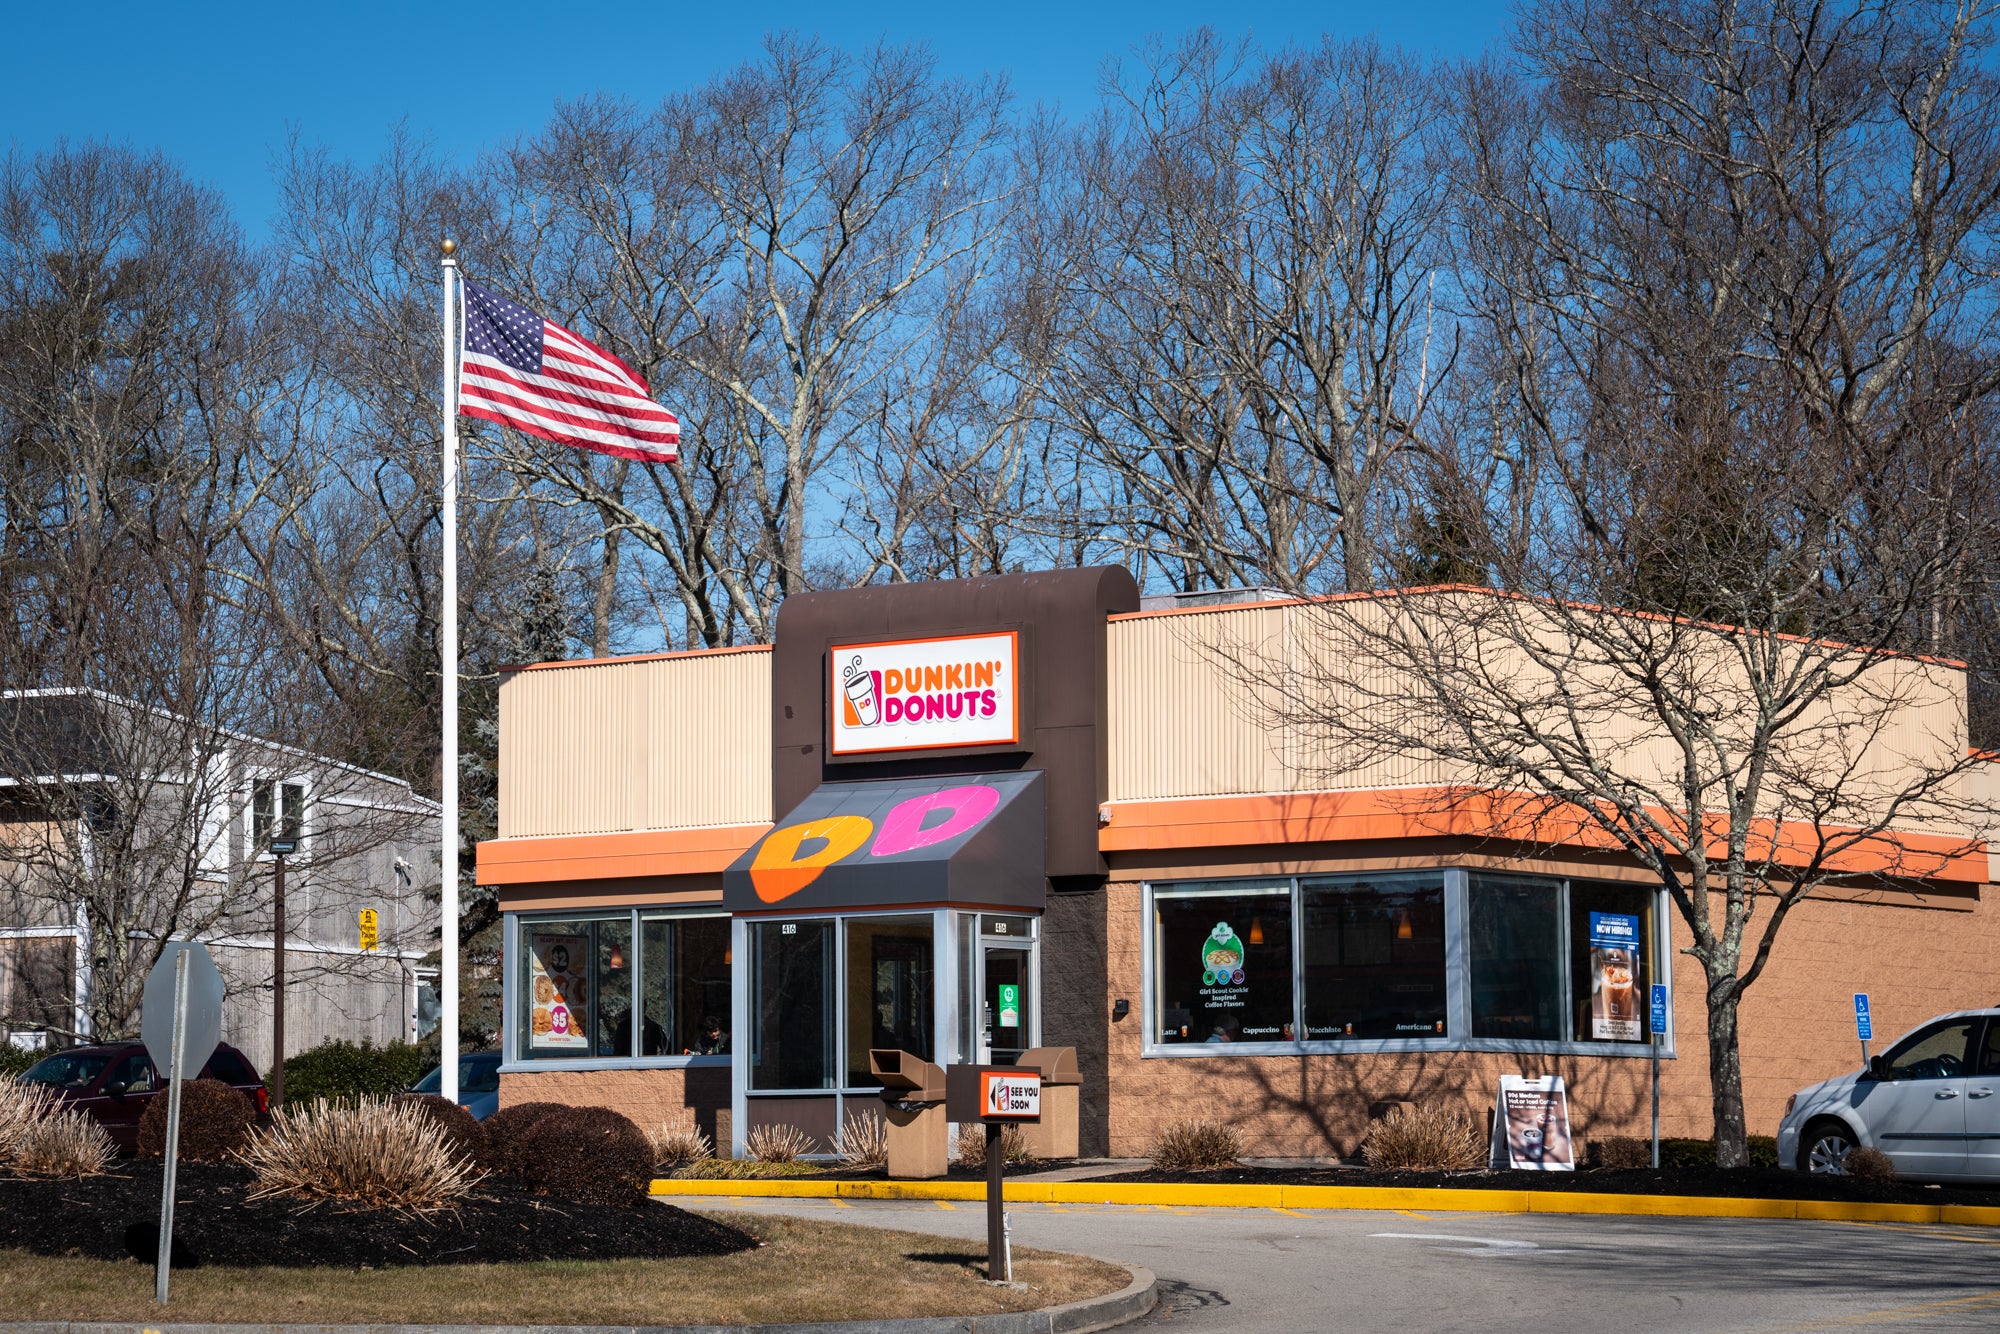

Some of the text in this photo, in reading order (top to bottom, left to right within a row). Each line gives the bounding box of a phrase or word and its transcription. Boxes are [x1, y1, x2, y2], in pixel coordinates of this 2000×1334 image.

[884, 660, 1001, 694] DUNKIN'
[885, 690, 996, 722] DONUTS
[783, 924, 796, 934] 416
[996, 923, 1006, 932] 416
[1596, 924, 1632, 936] NOW HIRING!
[552, 950, 567, 966] $2
[552, 1012, 567, 1028] $5
[1010, 1086, 1038, 1097] SEE YOU
[1010, 1100, 1030, 1110] SOON
